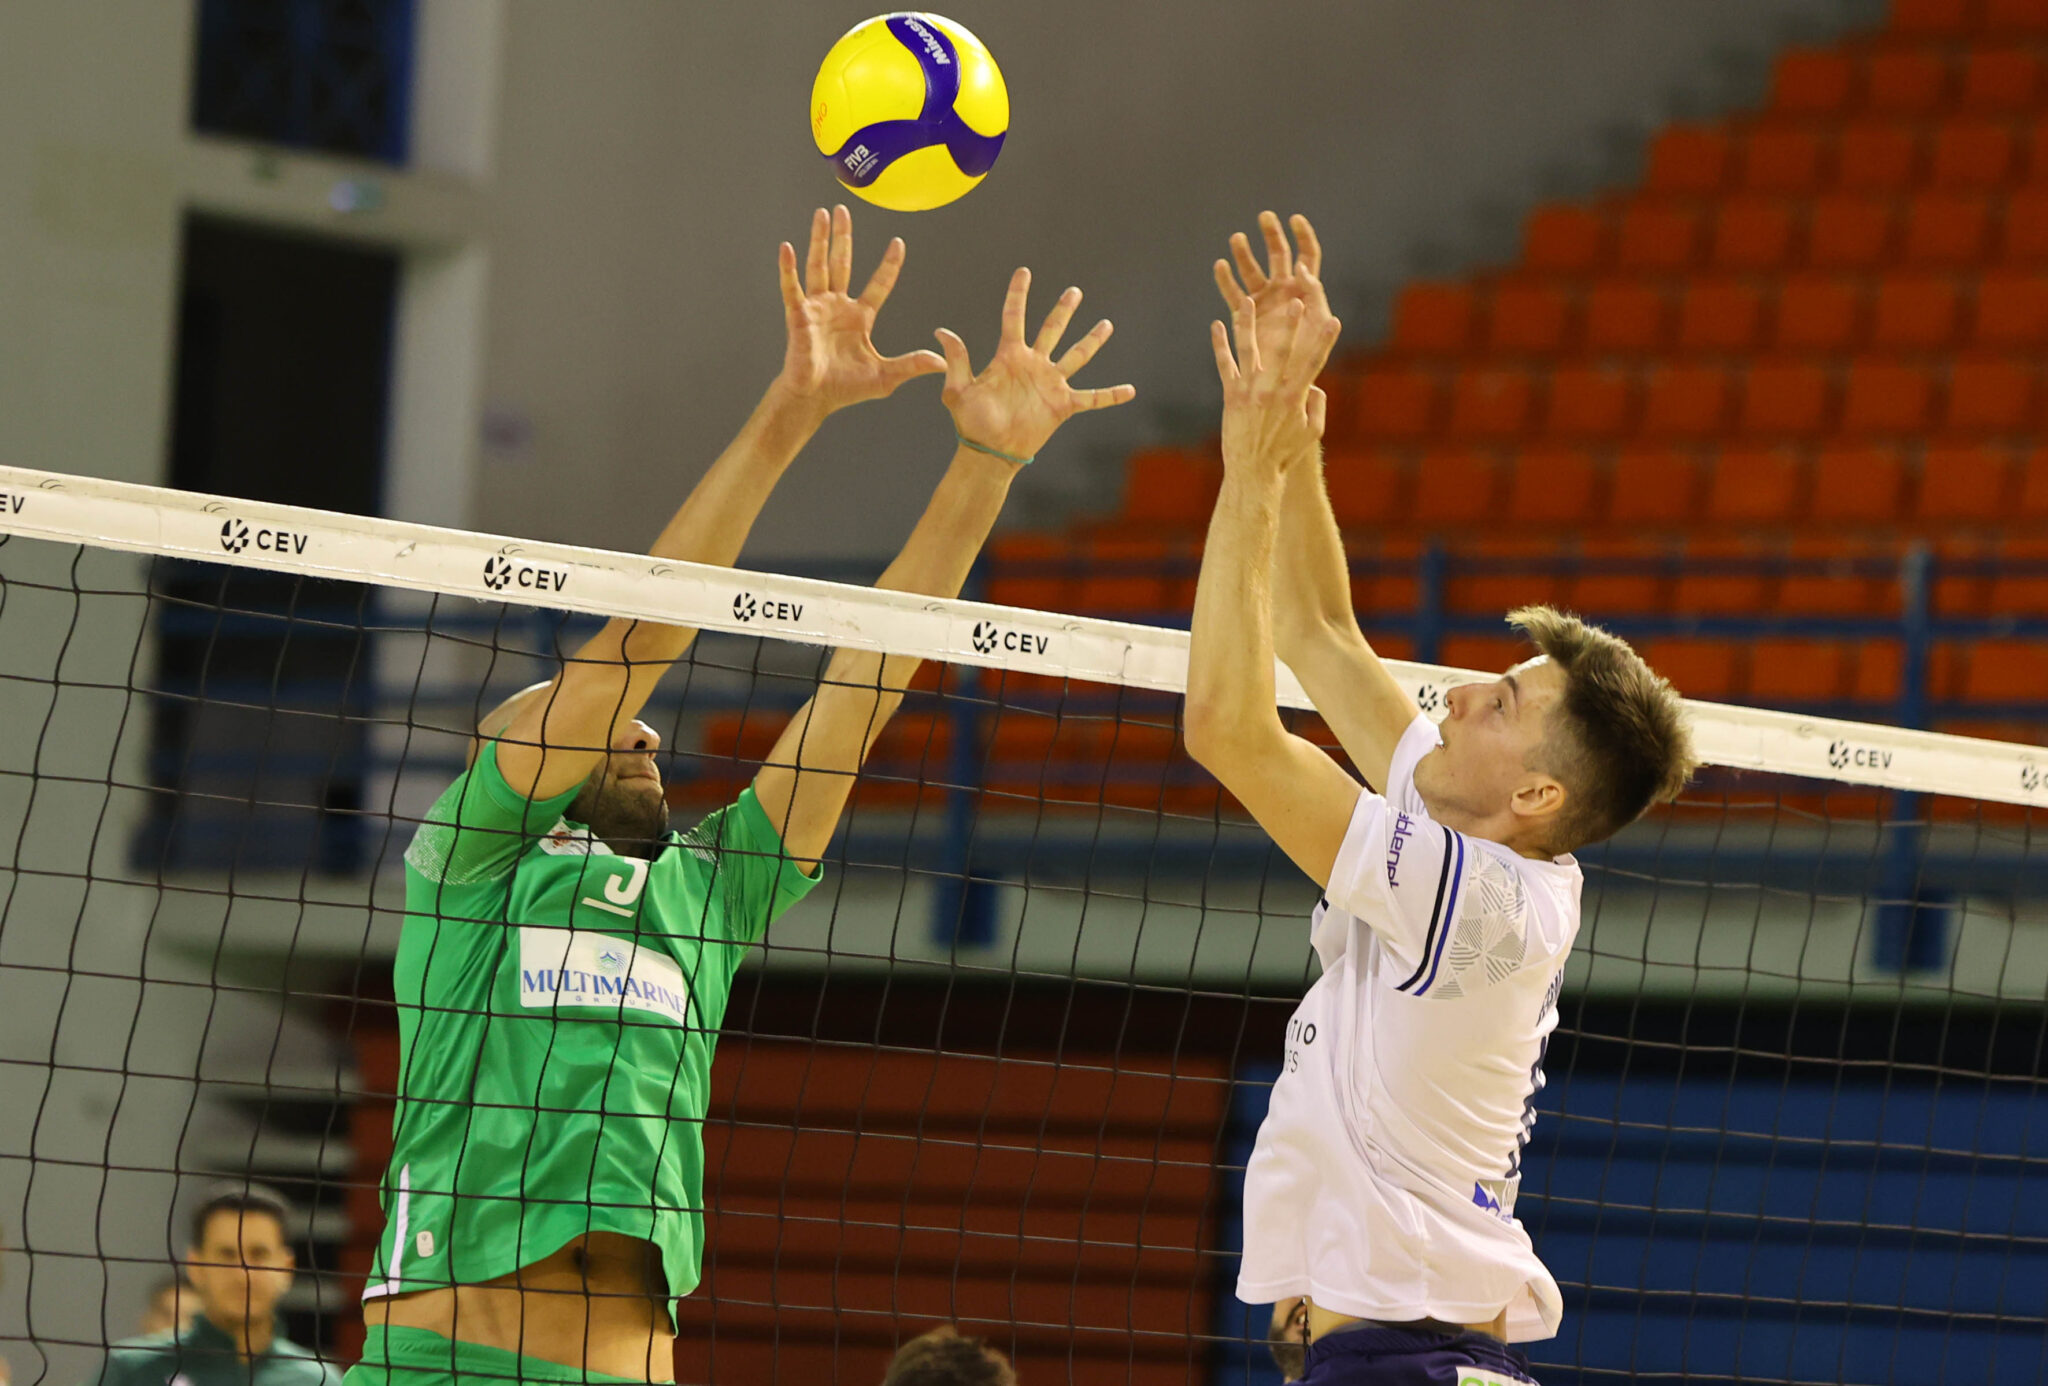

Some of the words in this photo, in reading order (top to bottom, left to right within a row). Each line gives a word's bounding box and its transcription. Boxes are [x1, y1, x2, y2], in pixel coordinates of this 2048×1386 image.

[844, 145, 870, 170] FIVB
[256, 529, 308, 555] CEV
[518, 567, 568, 592] CEV
[762, 600, 803, 622] CEV
[1004, 631, 1049, 655] CEV
[1856, 749, 1892, 769] CEV
[522, 969, 686, 1016] MULTIMARINE
[575, 995, 651, 1008] GROUP
